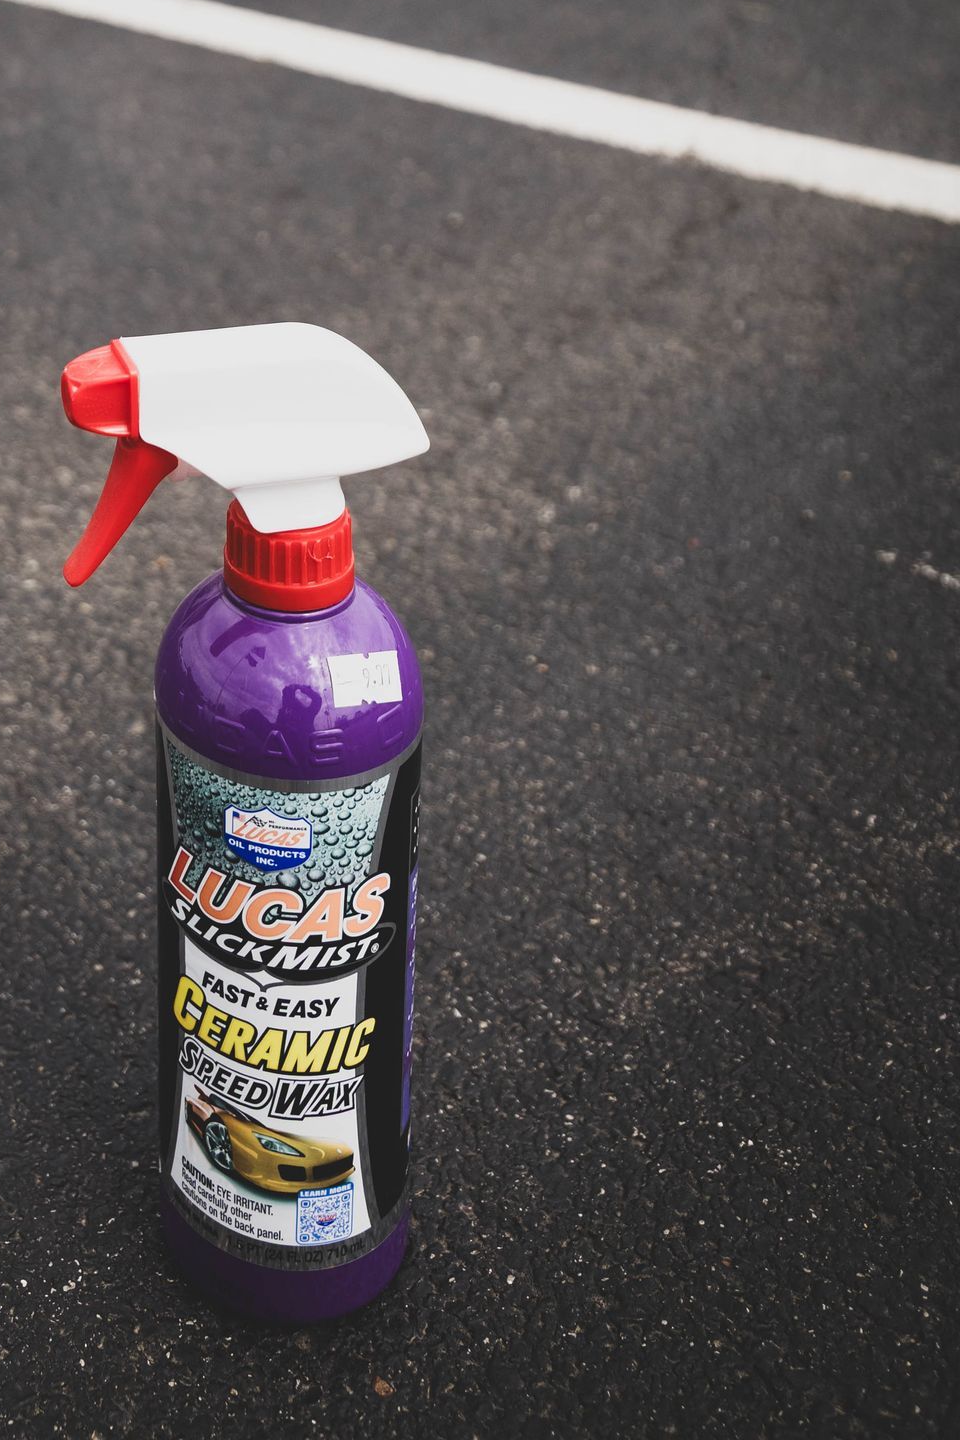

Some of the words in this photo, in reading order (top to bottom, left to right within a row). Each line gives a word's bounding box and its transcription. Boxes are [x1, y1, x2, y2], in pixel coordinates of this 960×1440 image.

[228, 838, 246, 850] OIL
[247, 844, 307, 859] PRODUCTS
[233, 823, 305, 847] LUCAS
[255, 856, 278, 867] INC.
[167, 845, 392, 944] LUCAS
[201, 971, 255, 1008] FAST
[255, 996, 270, 1011] &
[272, 996, 341, 1019] EASY
[172, 975, 377, 1074] CERAMIC
[179, 1036, 274, 1110] SPEED
[268, 1075, 365, 1121] WAX
[181, 1155, 215, 1192] CAUTION:
[216, 1185, 232, 1202] EYE
[233, 1194, 274, 1216] IRRITANT.
[181, 1167, 197, 1189] Read
[197, 1185, 229, 1214] carefully
[230, 1206, 252, 1222] other
[181, 1181, 208, 1210] cautions
[208, 1206, 218, 1218] on
[220, 1211, 233, 1226] the
[234, 1218, 255, 1235] back
[256, 1228, 284, 1241] panel.
[300, 1189, 328, 1198] LEARN
[329, 1183, 352, 1195] MORE
[327, 1245, 348, 1261] 710
